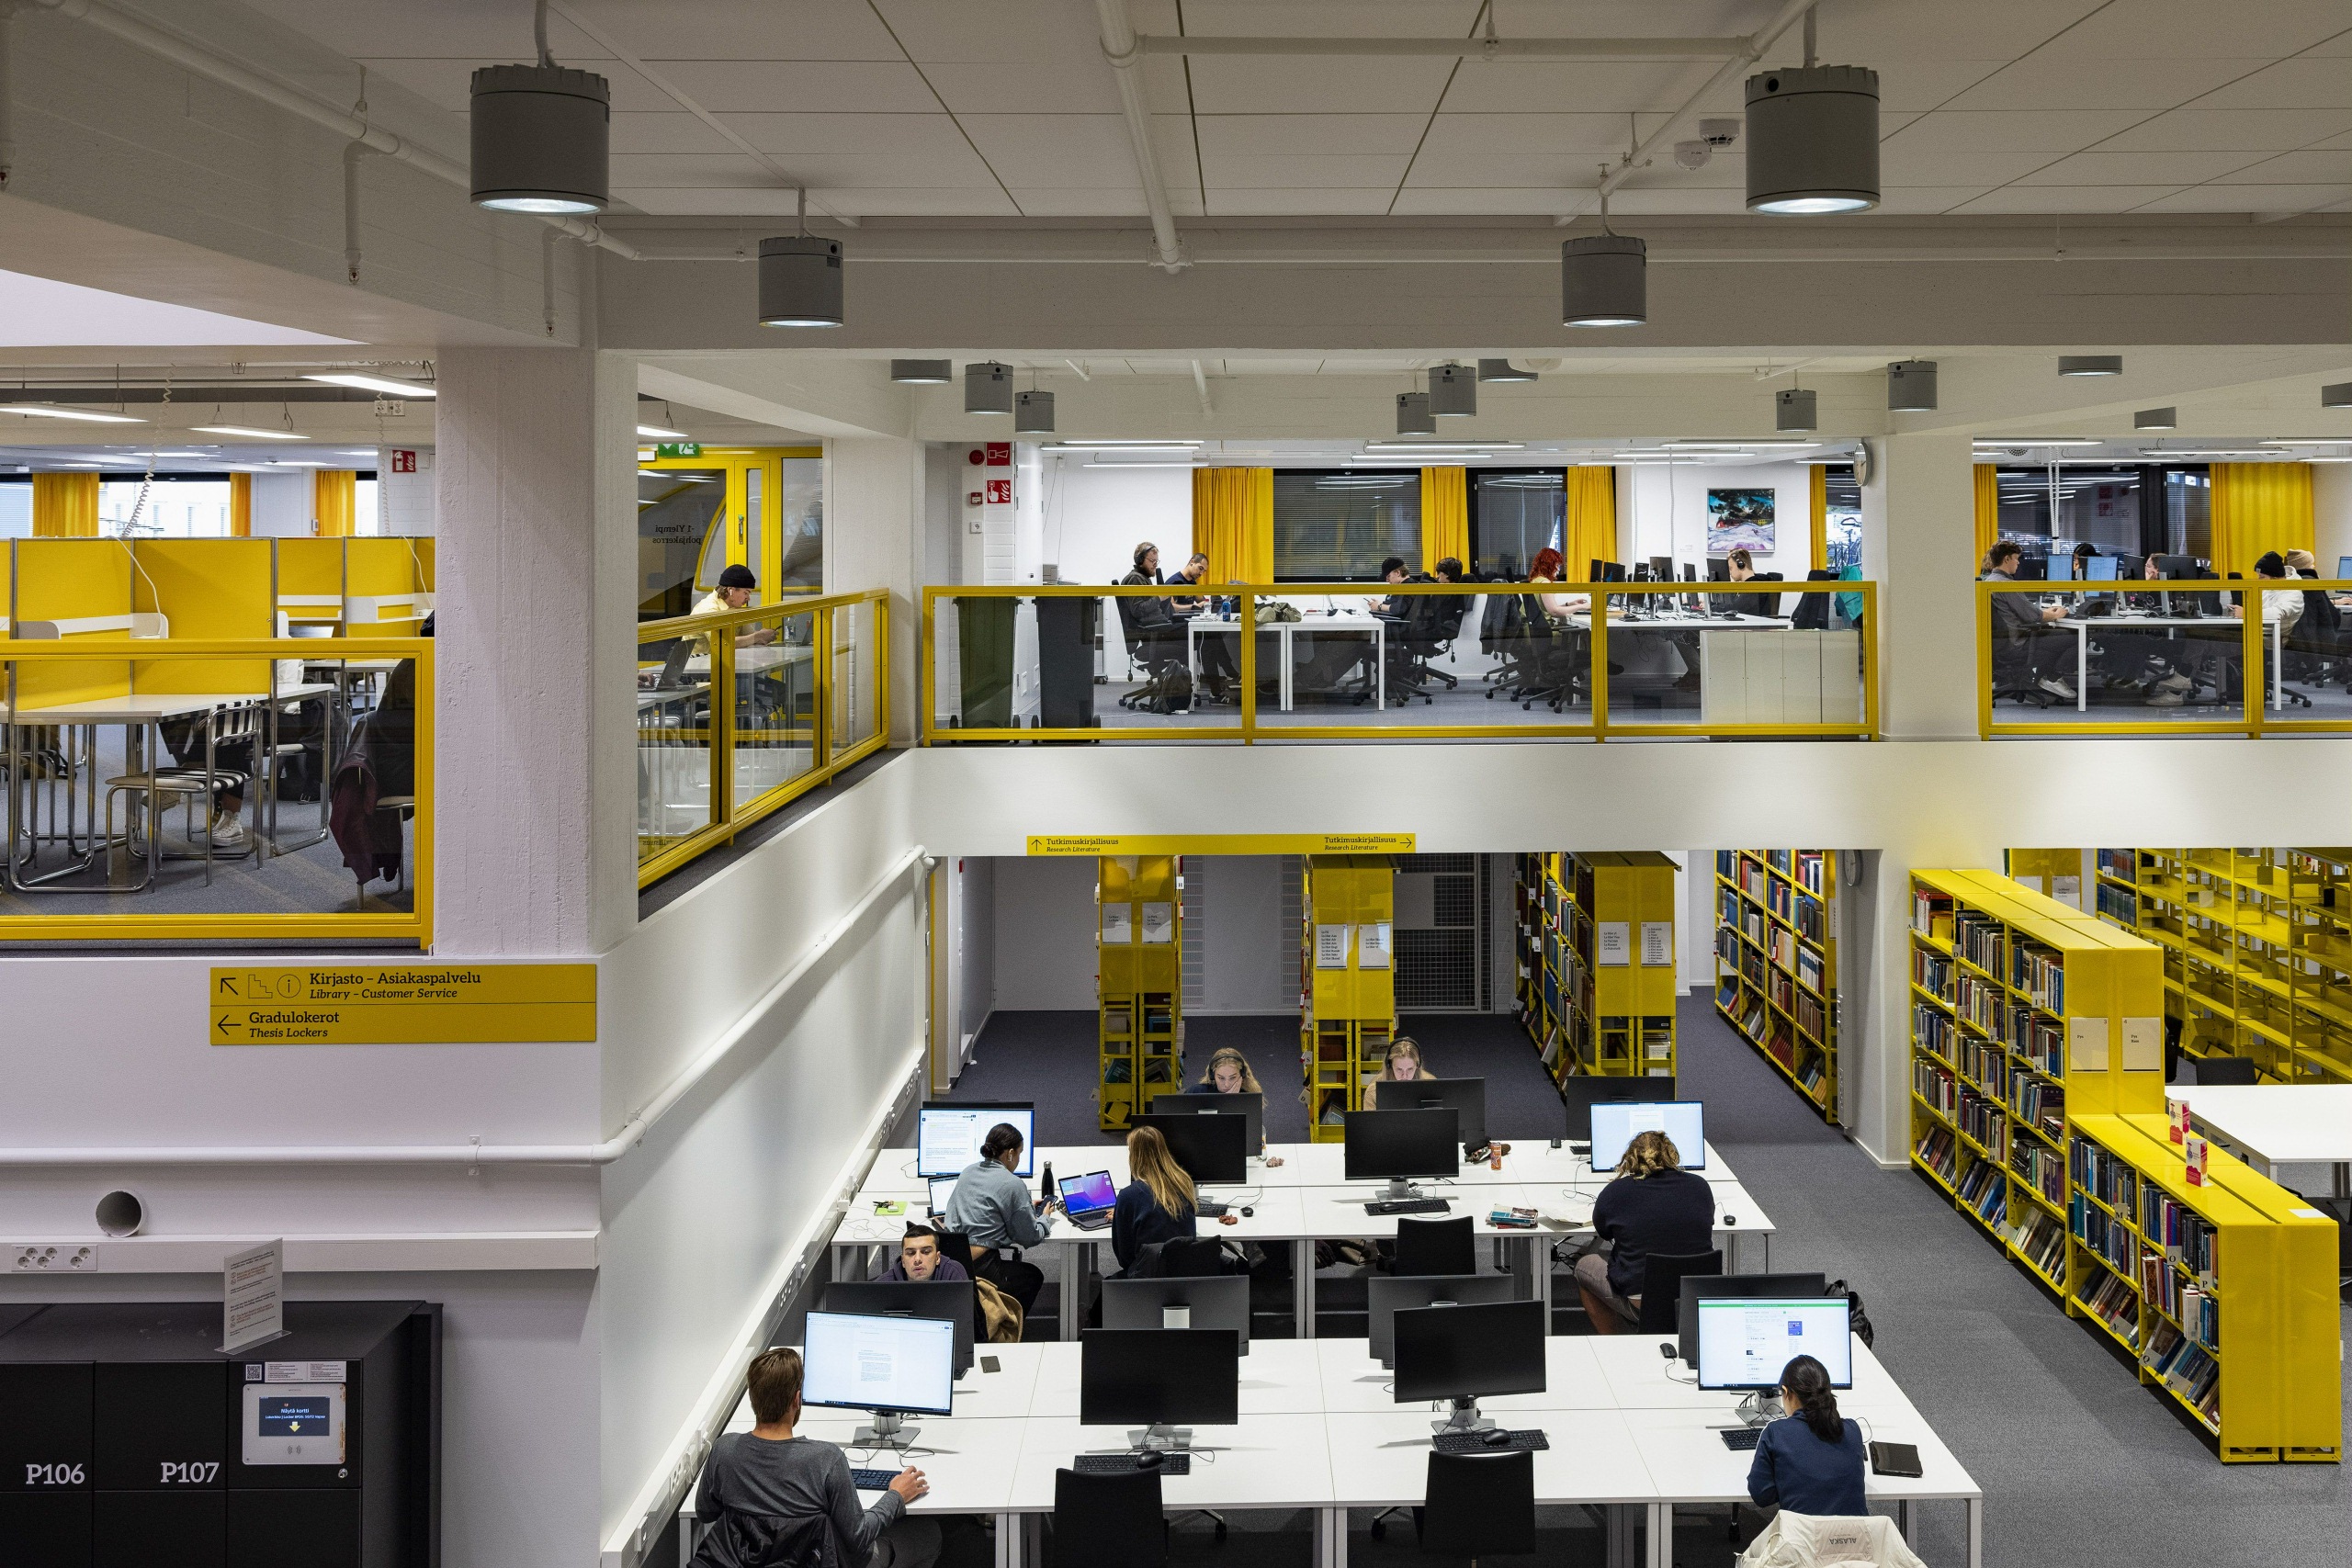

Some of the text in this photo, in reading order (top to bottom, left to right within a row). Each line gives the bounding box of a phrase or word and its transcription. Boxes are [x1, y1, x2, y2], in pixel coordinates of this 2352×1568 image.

[1046, 838, 1119, 846] Tutkimuskirjallisuus
[1324, 836, 1396, 844] Tutkimuskirjallisuus
[310, 972, 364, 986] Kirjasto
[377, 971, 481, 986] Asiakaspalvelu
[309, 988, 351, 1000] Library
[361, 988, 415, 998] Customer
[416, 987, 458, 998] Service
[249, 1010, 340, 1024] Gradulokerot
[249, 1027, 328, 1038] Thesis Lockers
[2168, 1255, 2177, 1263] O
[2143, 1354, 2151, 1365] Q
[2165, 1379, 2175, 1389] R
[26, 1464, 85, 1484] P106
[160, 1462, 220, 1483] P107
[1828, 1537, 1857, 1545] ALASKA
